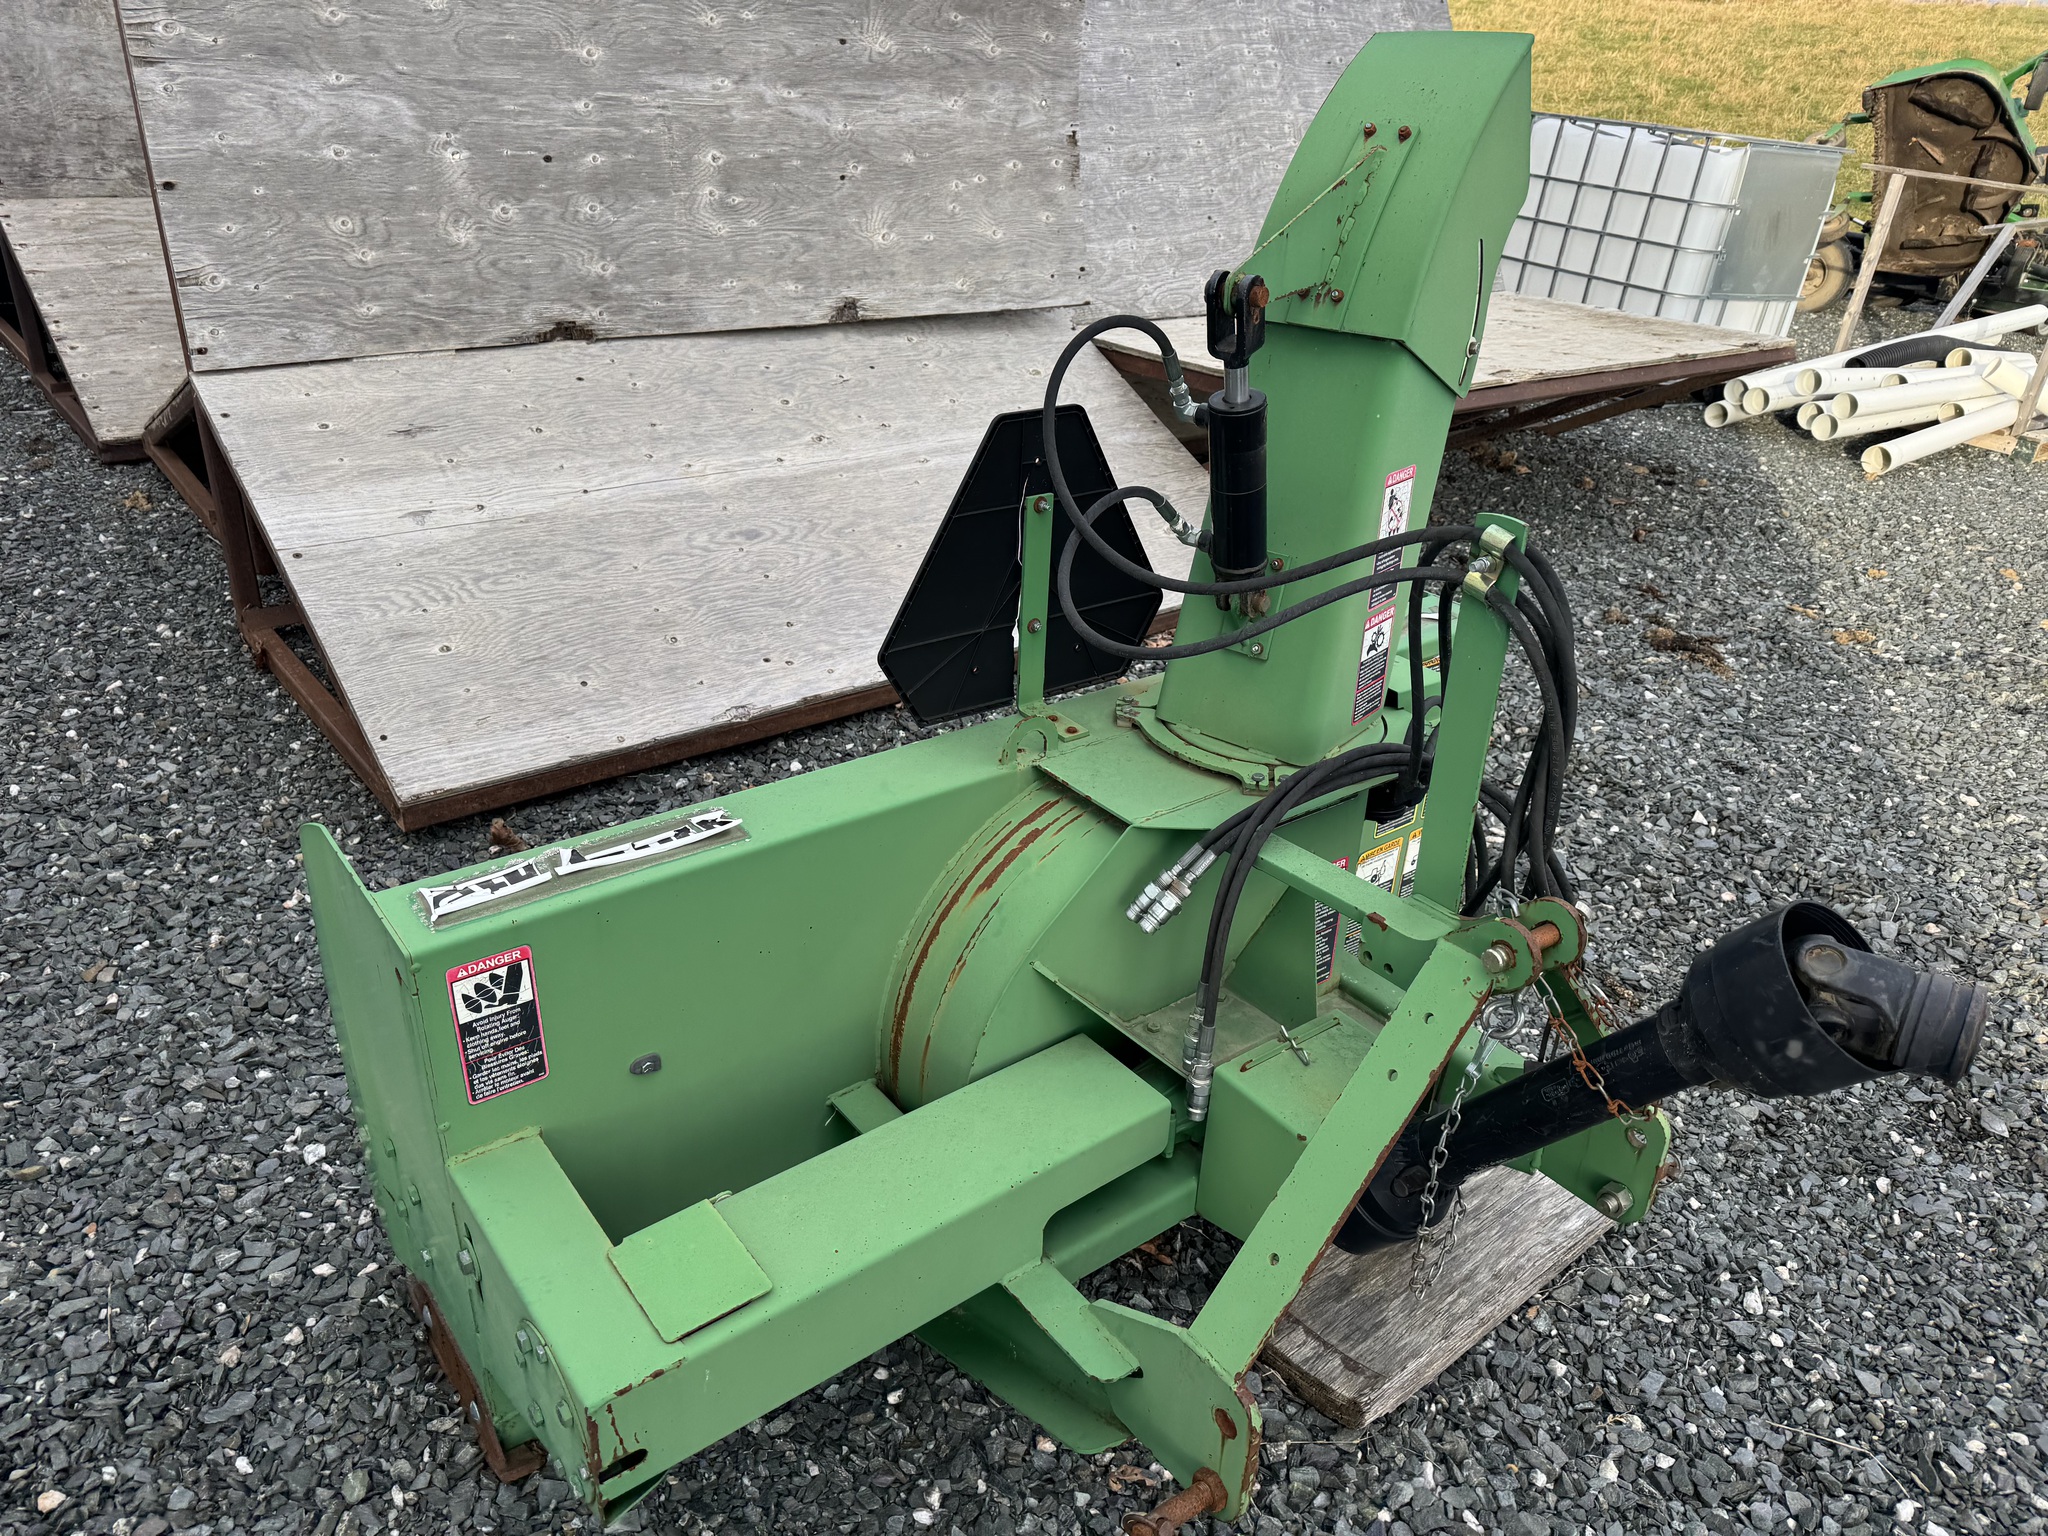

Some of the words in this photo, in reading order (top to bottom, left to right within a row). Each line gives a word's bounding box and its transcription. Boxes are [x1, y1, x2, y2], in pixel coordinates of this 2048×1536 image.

[1392, 466, 1414, 484] DANGER
[1370, 606, 1394, 627] DANGER
[468, 950, 522, 975] DANGER
[472, 1018, 488, 1027] Avoid
[489, 1011, 505, 1022] Injury
[506, 1006, 521, 1015] From
[476, 1019, 500, 1032] Rotating
[465, 1033, 480, 1043] Keep
[510, 1019, 520, 1027] and
[466, 1036, 489, 1049] clothing
[489, 1031, 505, 1041] away.
[467, 1045, 480, 1054] Shut
[489, 1036, 508, 1047] engine
[509, 1029, 526, 1039] before
